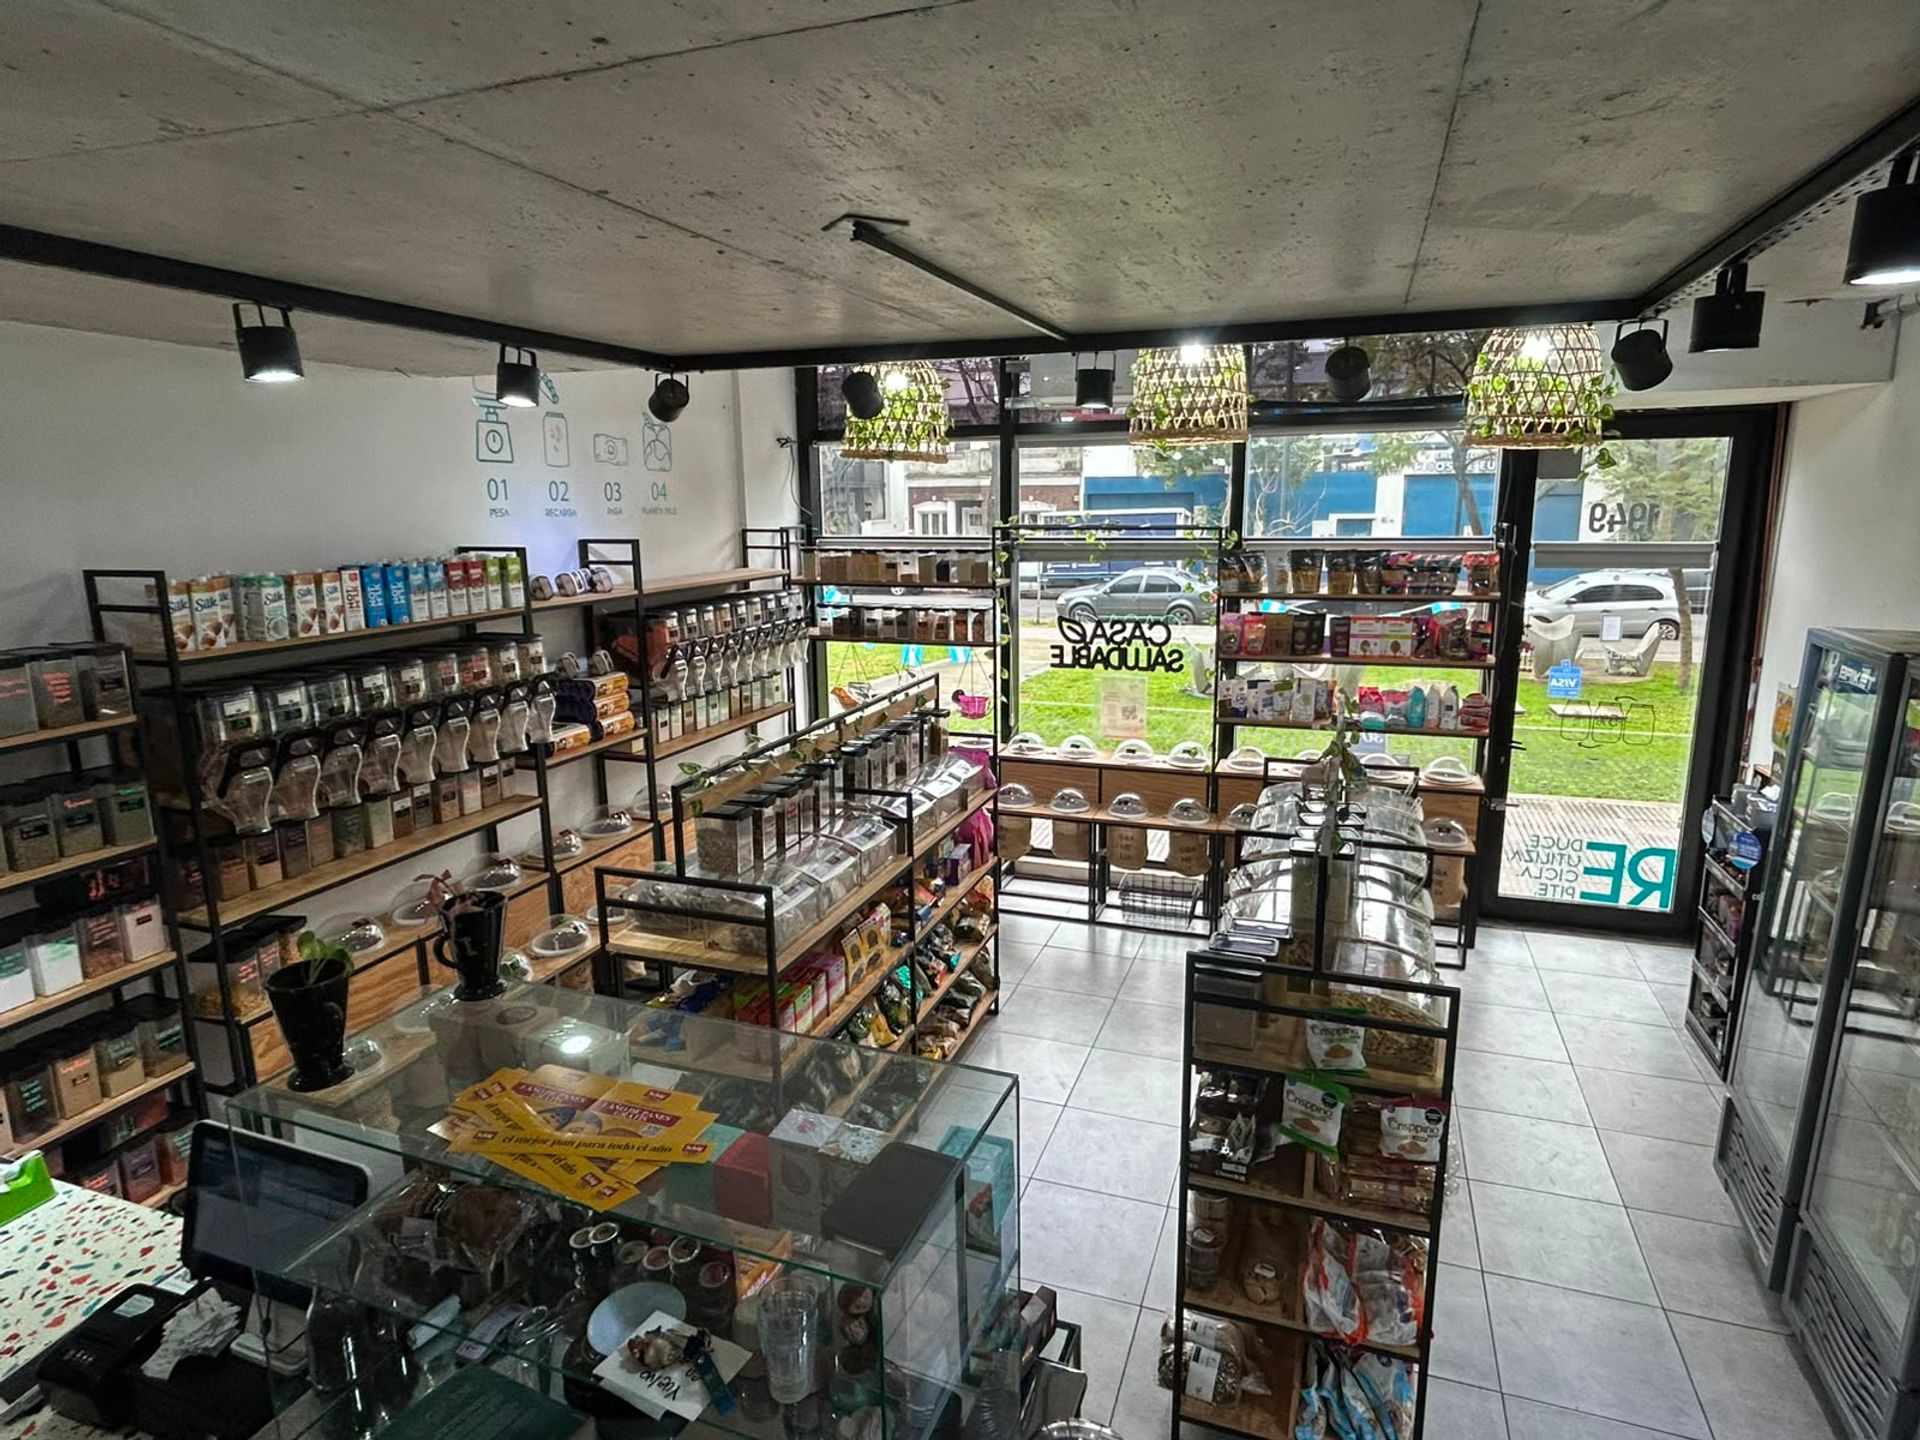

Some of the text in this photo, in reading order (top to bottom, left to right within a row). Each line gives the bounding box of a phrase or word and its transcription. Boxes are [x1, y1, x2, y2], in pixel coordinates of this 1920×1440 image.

[487, 478, 508, 501] 01
[549, 480, 570, 502] 02
[604, 482, 622, 502] 03
[651, 482, 668, 501] 04
[264, 590, 284, 606] Silk
[297, 587, 315, 600] Silk
[195, 596, 218, 613] Silk
[575, 1141, 605, 1150] para
[608, 1142, 635, 1151] todo
[636, 1144, 649, 1152] el
